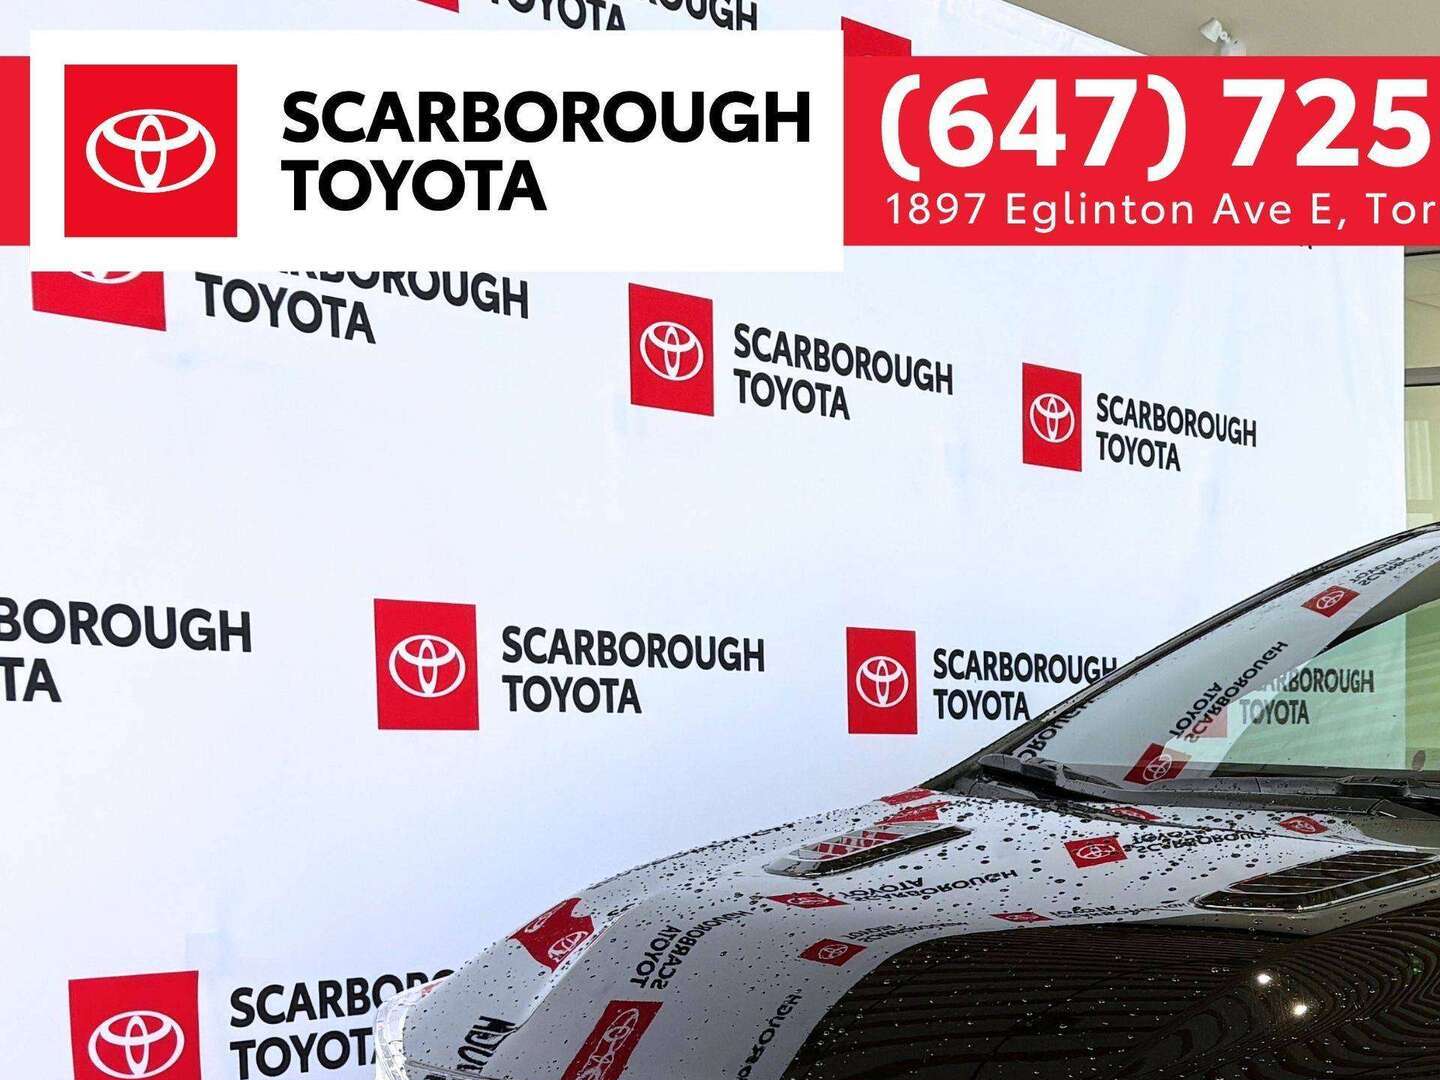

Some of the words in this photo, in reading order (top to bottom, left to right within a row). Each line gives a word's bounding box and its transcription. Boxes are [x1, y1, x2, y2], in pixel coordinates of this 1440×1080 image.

[195, 272, 376, 345] TOYOTA
[734, 323, 953, 396] SCARBOROUGH
[734, 370, 850, 420] TOYOTA
[1096, 393, 1256, 448] SCARBOROUGH
[1096, 432, 1180, 472] TOYOTA
[503, 626, 764, 671] SCARBOROUGH
[502, 675, 642, 714] TOYOTA
[934, 689, 1030, 720] TOYOTA
[1240, 699, 1310, 725] TOYOTA
[230, 1027, 375, 1080] TOYOT
